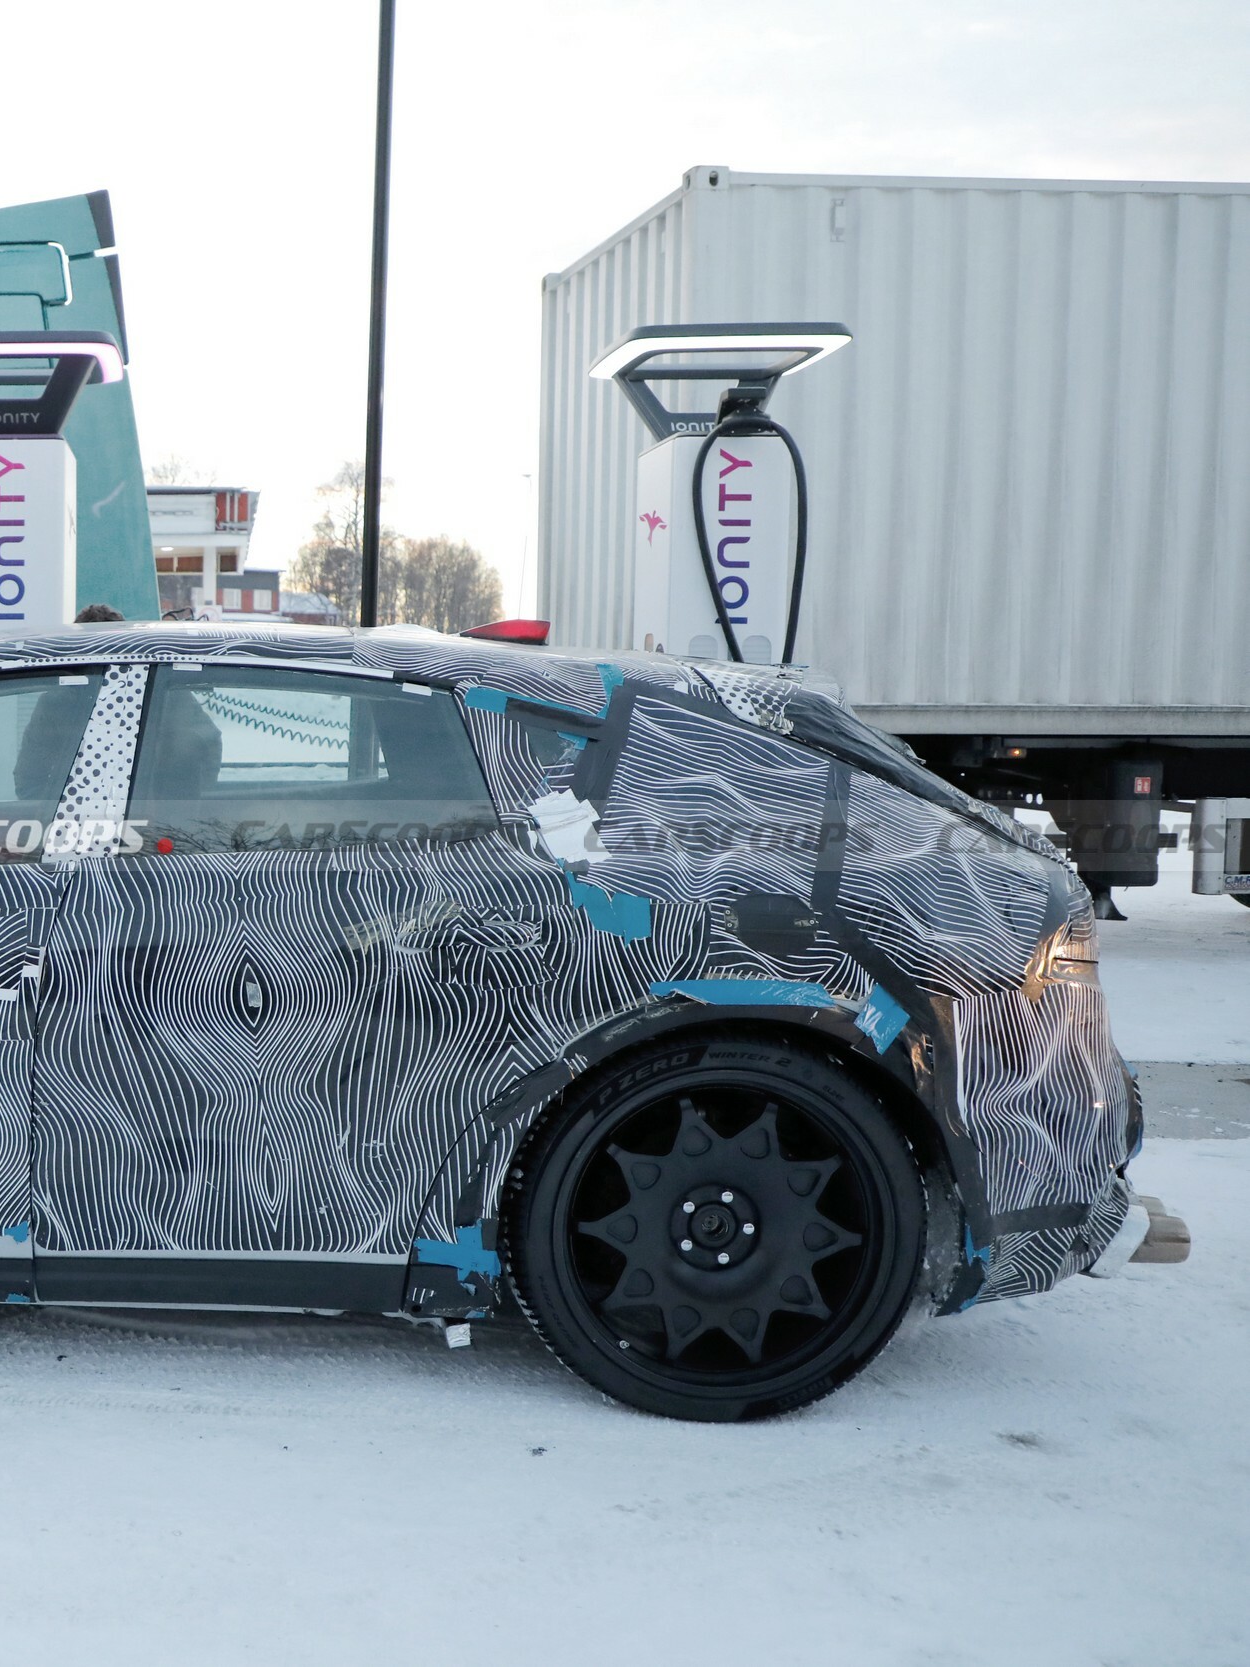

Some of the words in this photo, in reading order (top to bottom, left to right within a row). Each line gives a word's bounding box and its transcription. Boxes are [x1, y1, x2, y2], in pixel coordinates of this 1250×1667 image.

[671, 421, 715, 432] IONIT
[715, 449, 753, 624] IONITY
[599, 1087, 613, 1105] P
[618, 1052, 689, 1090] ZERO
[709, 1052, 770, 1063] WINTER
[775, 1057, 791, 1067] 2
